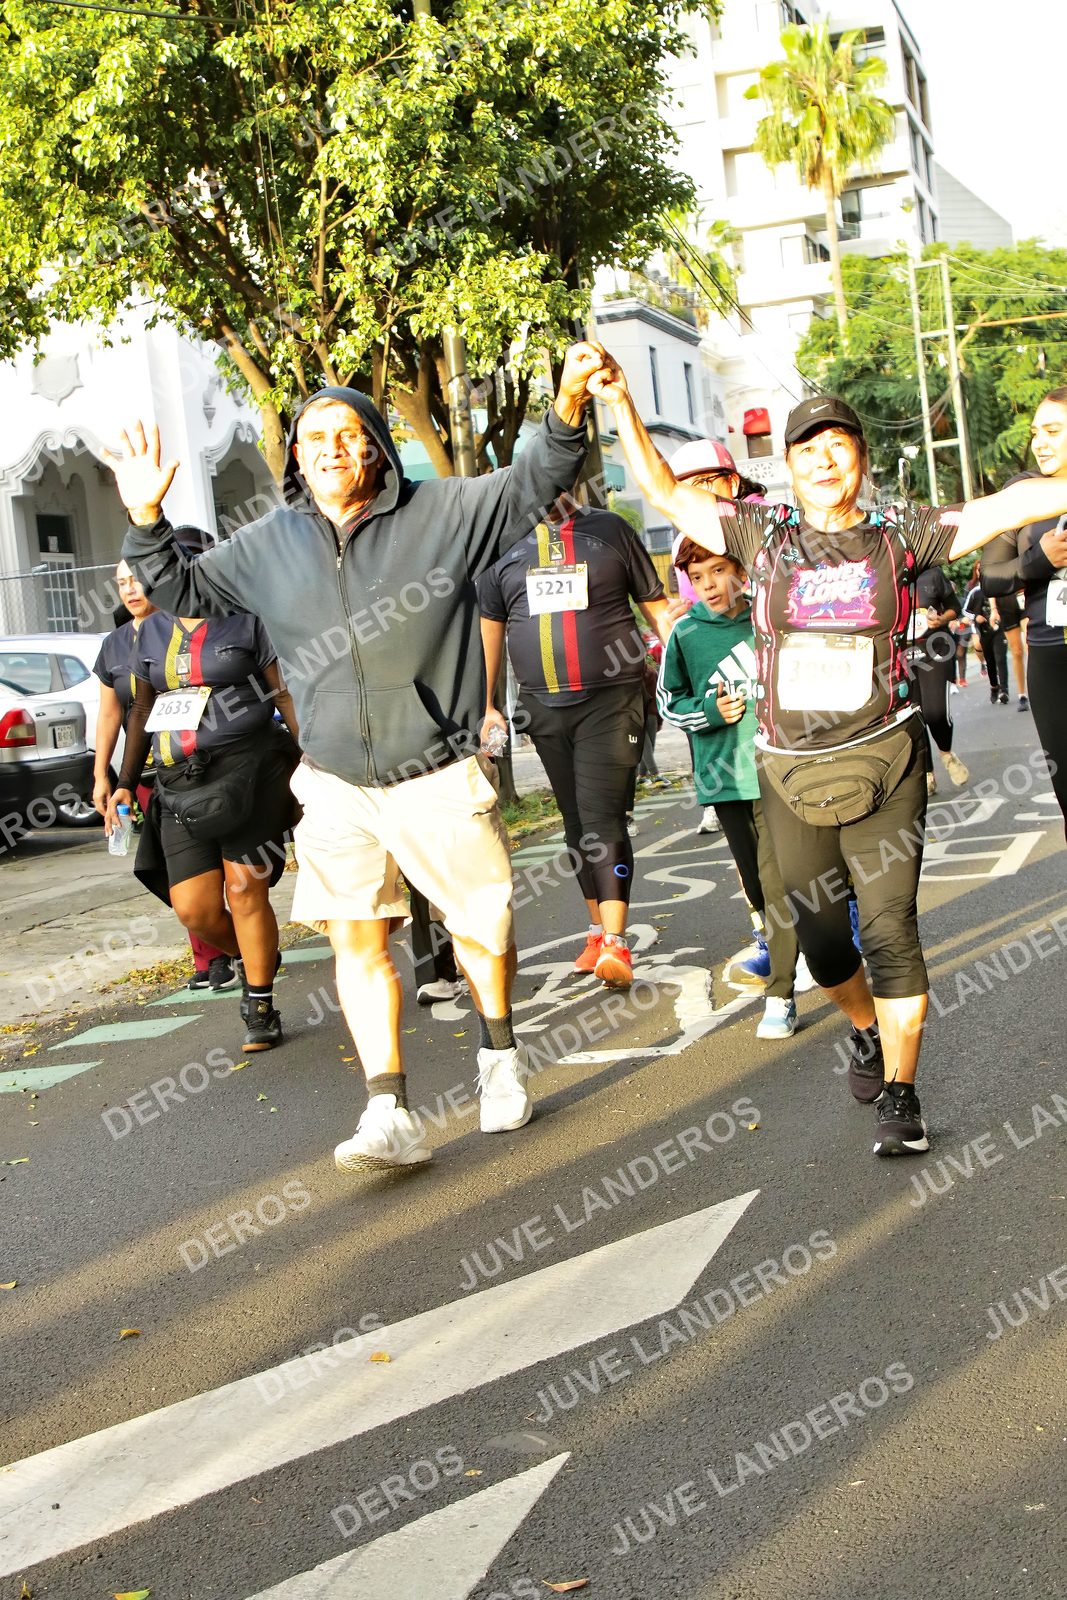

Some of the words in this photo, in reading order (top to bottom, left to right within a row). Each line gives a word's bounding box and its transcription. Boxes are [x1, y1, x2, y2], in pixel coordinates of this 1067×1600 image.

[799, 560, 870, 585] POWER
[535, 580, 574, 596] 5221
[156, 700, 193, 716] 2635
